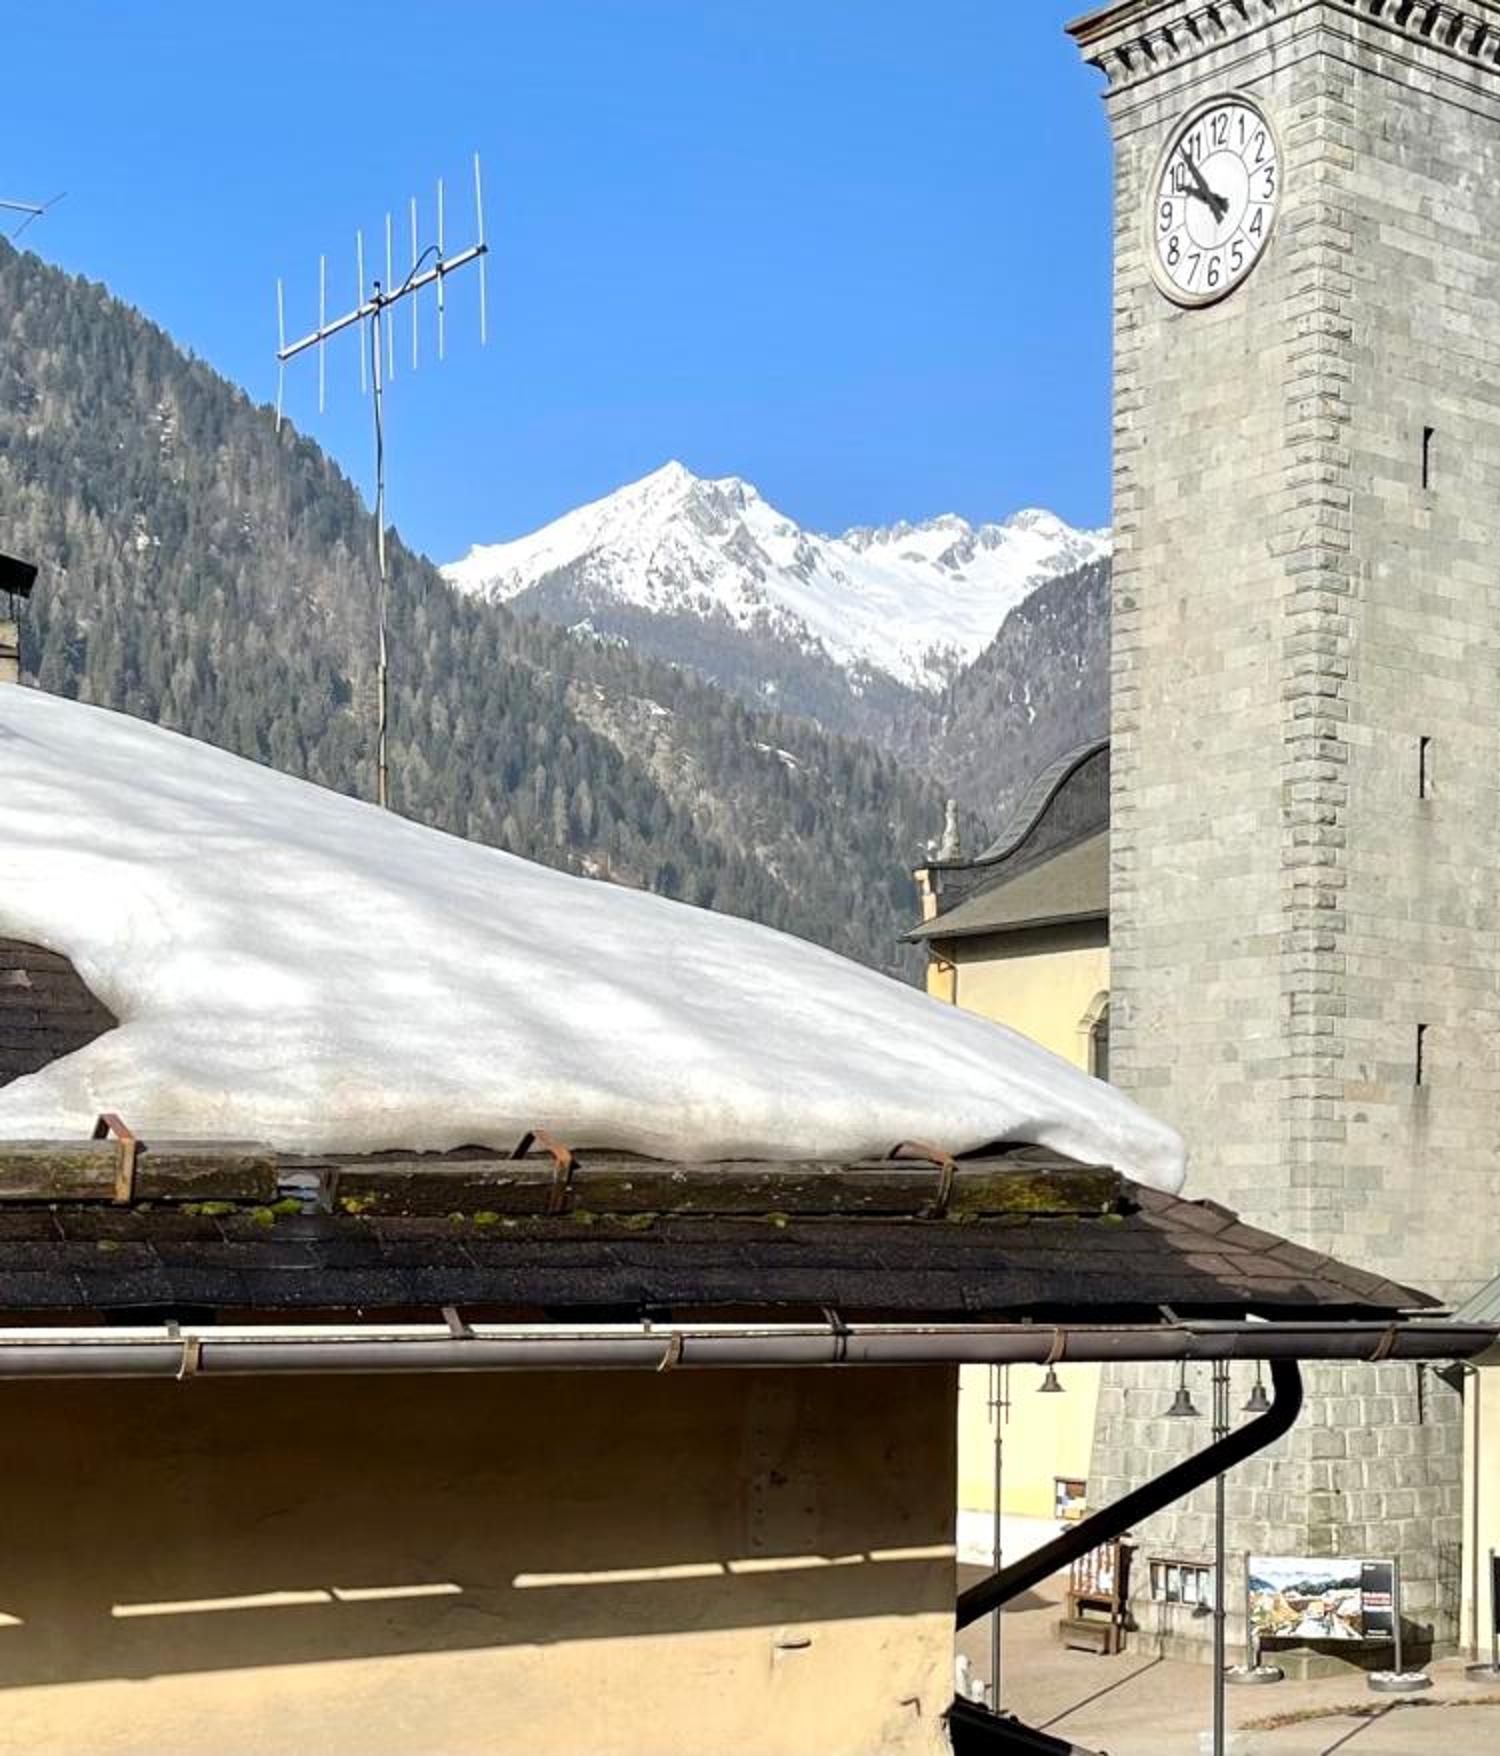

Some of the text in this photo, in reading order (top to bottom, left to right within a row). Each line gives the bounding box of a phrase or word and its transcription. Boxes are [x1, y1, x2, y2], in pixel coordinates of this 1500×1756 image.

[1210, 113, 1228, 147] 12
[1238, 114, 1245, 145] 1
[1254, 131, 1265, 163] 2
[1169, 162, 1185, 195] 10
[1263, 166, 1275, 199] 3
[1159, 201, 1173, 232] 9
[1250, 208, 1263, 238] 4
[1167, 236, 1180, 266] 8
[1231, 240, 1244, 272] 5
[1187, 254, 1200, 285] 7
[1207, 256, 1220, 286] 6
